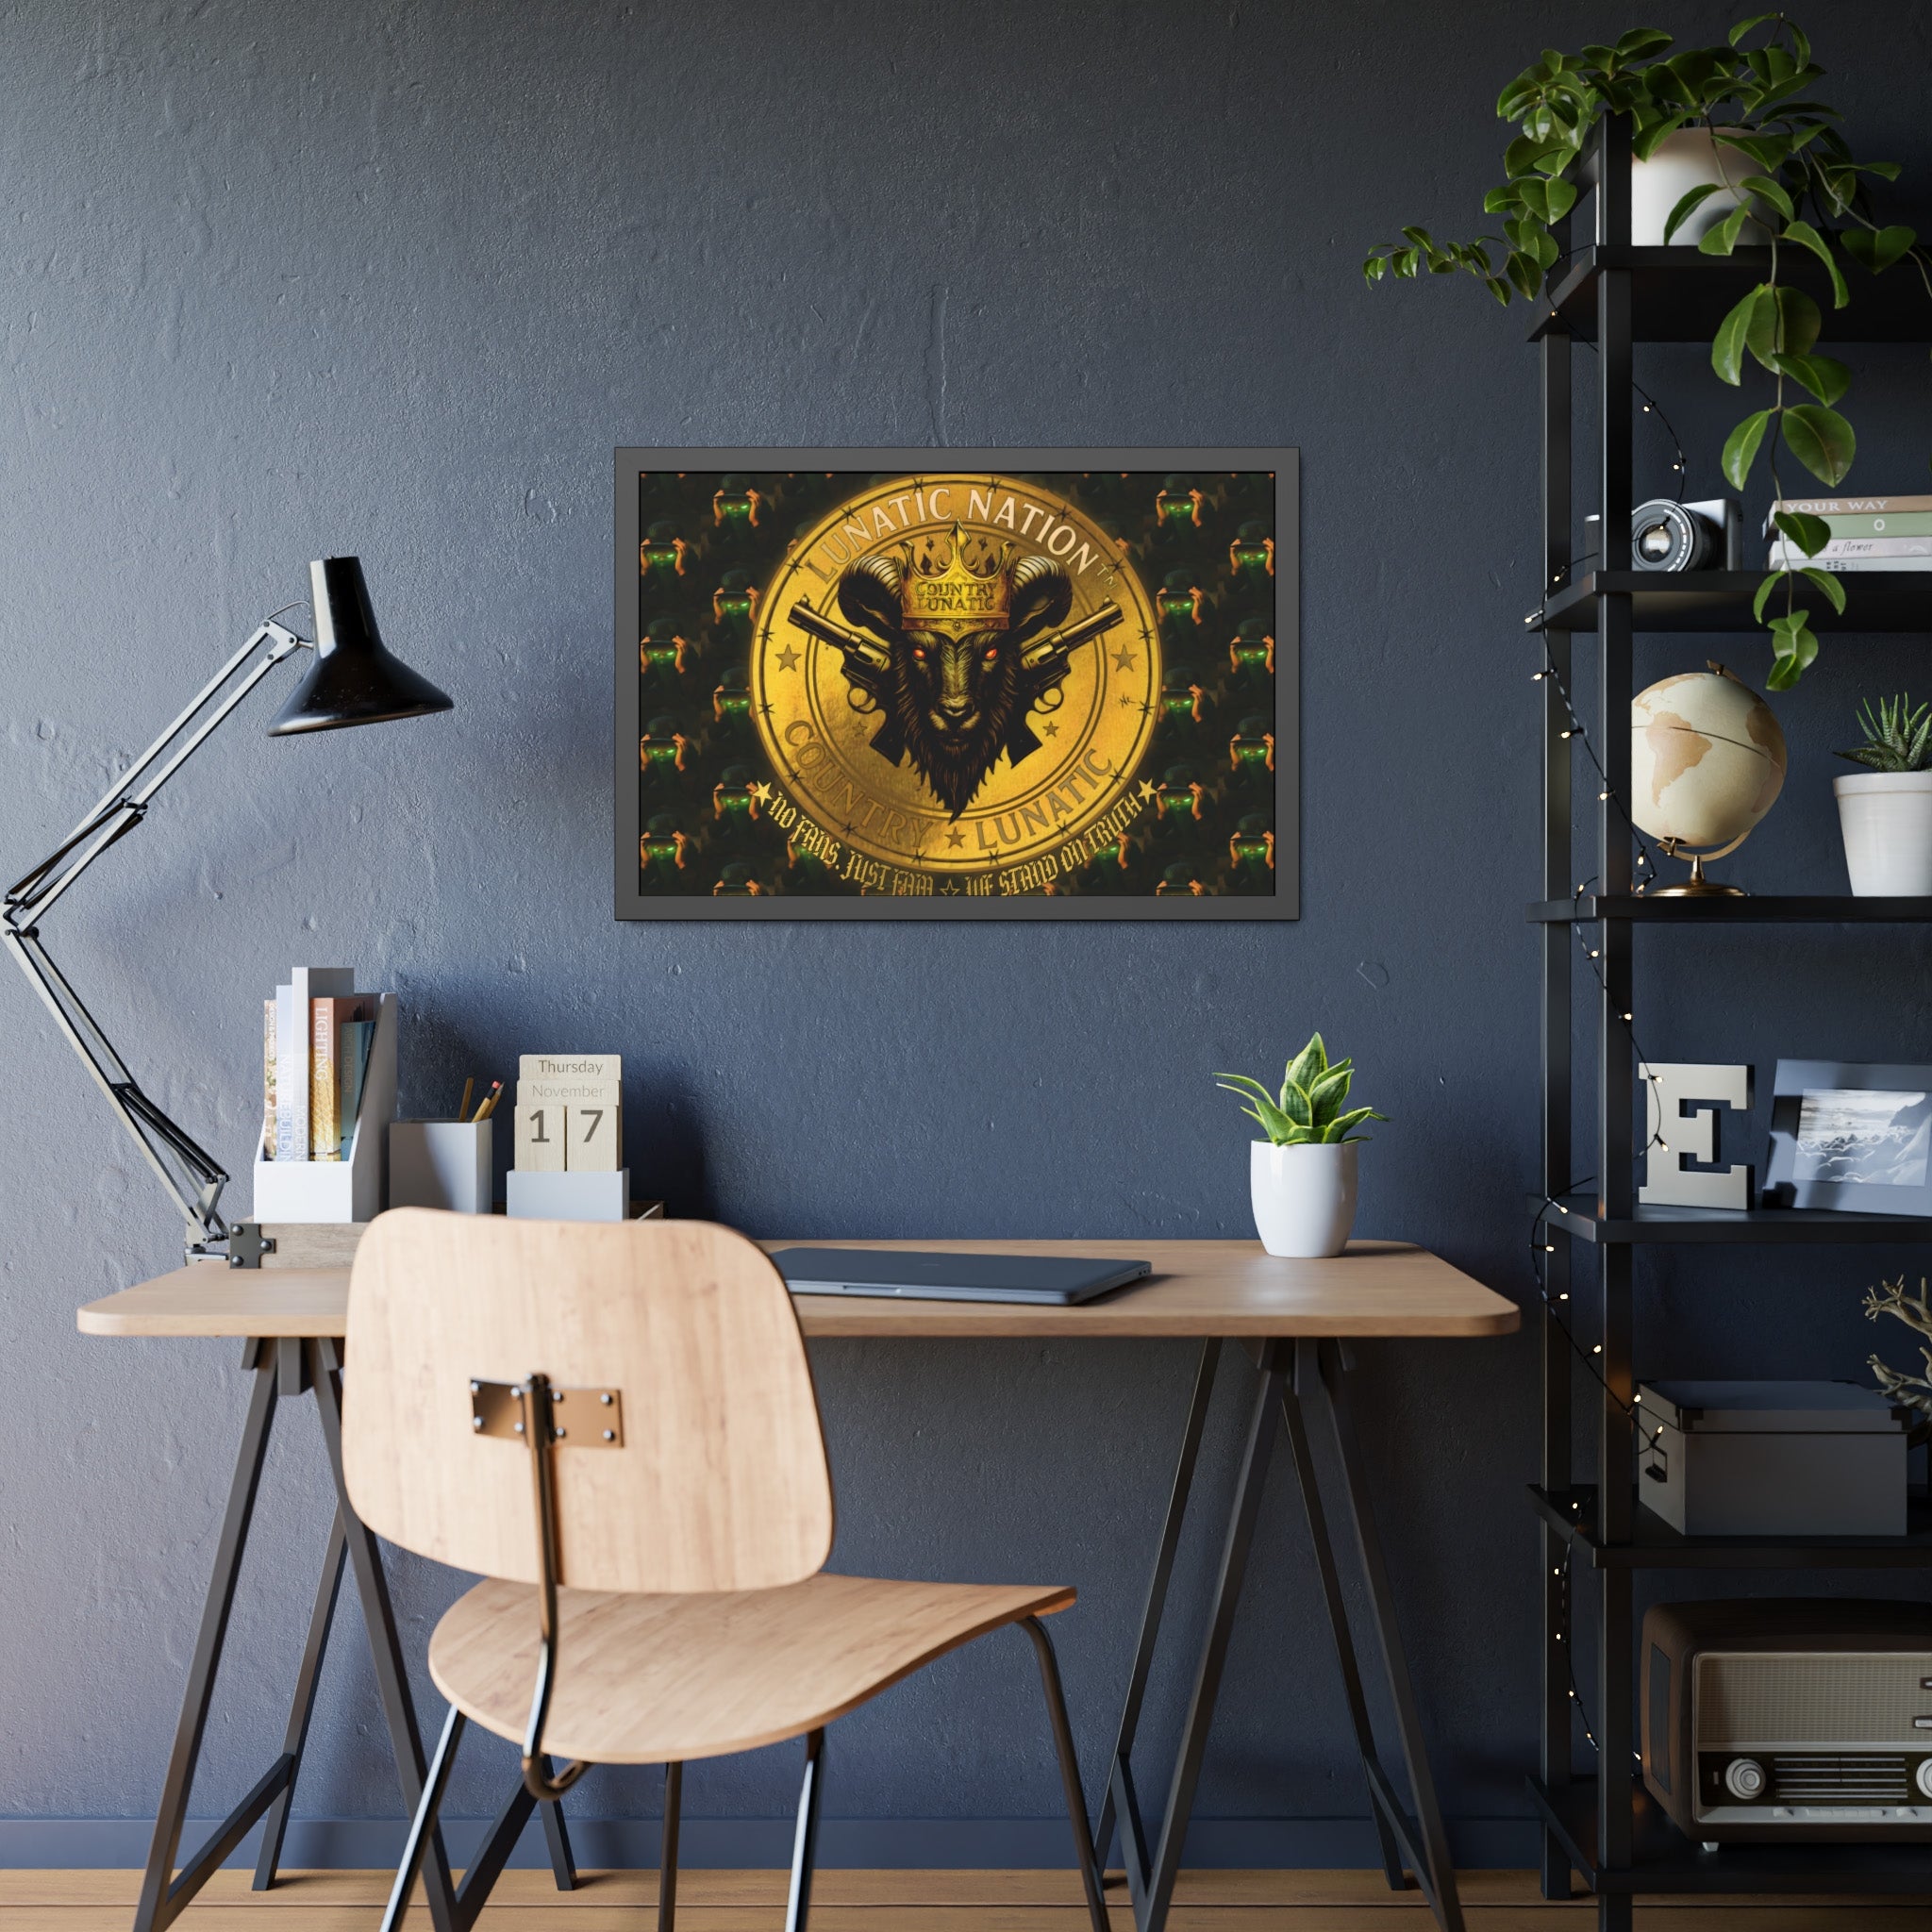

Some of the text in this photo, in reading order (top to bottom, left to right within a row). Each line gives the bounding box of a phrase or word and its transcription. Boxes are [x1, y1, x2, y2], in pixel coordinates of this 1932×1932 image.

[1787, 500, 1888, 512] YOUR WAY
[805, 489, 953, 584] LUNATIC
[967, 489, 1100, 576] NATION
[1840, 541, 1874, 556] flower
[915, 581, 996, 596] COUNTRY
[914, 596, 995, 611] LUNATIC
[784, 721, 1113, 850] COUNTRY LUNATIC
[1084, 791, 1143, 853] TRUTH
[315, 1008, 329, 1081] LIGHTING
[343, 1057, 353, 1092] DESIGN
[538, 1059, 604, 1075] Thursday
[532, 1085, 605, 1098] November
[294, 1105, 307, 1160] MODERN
